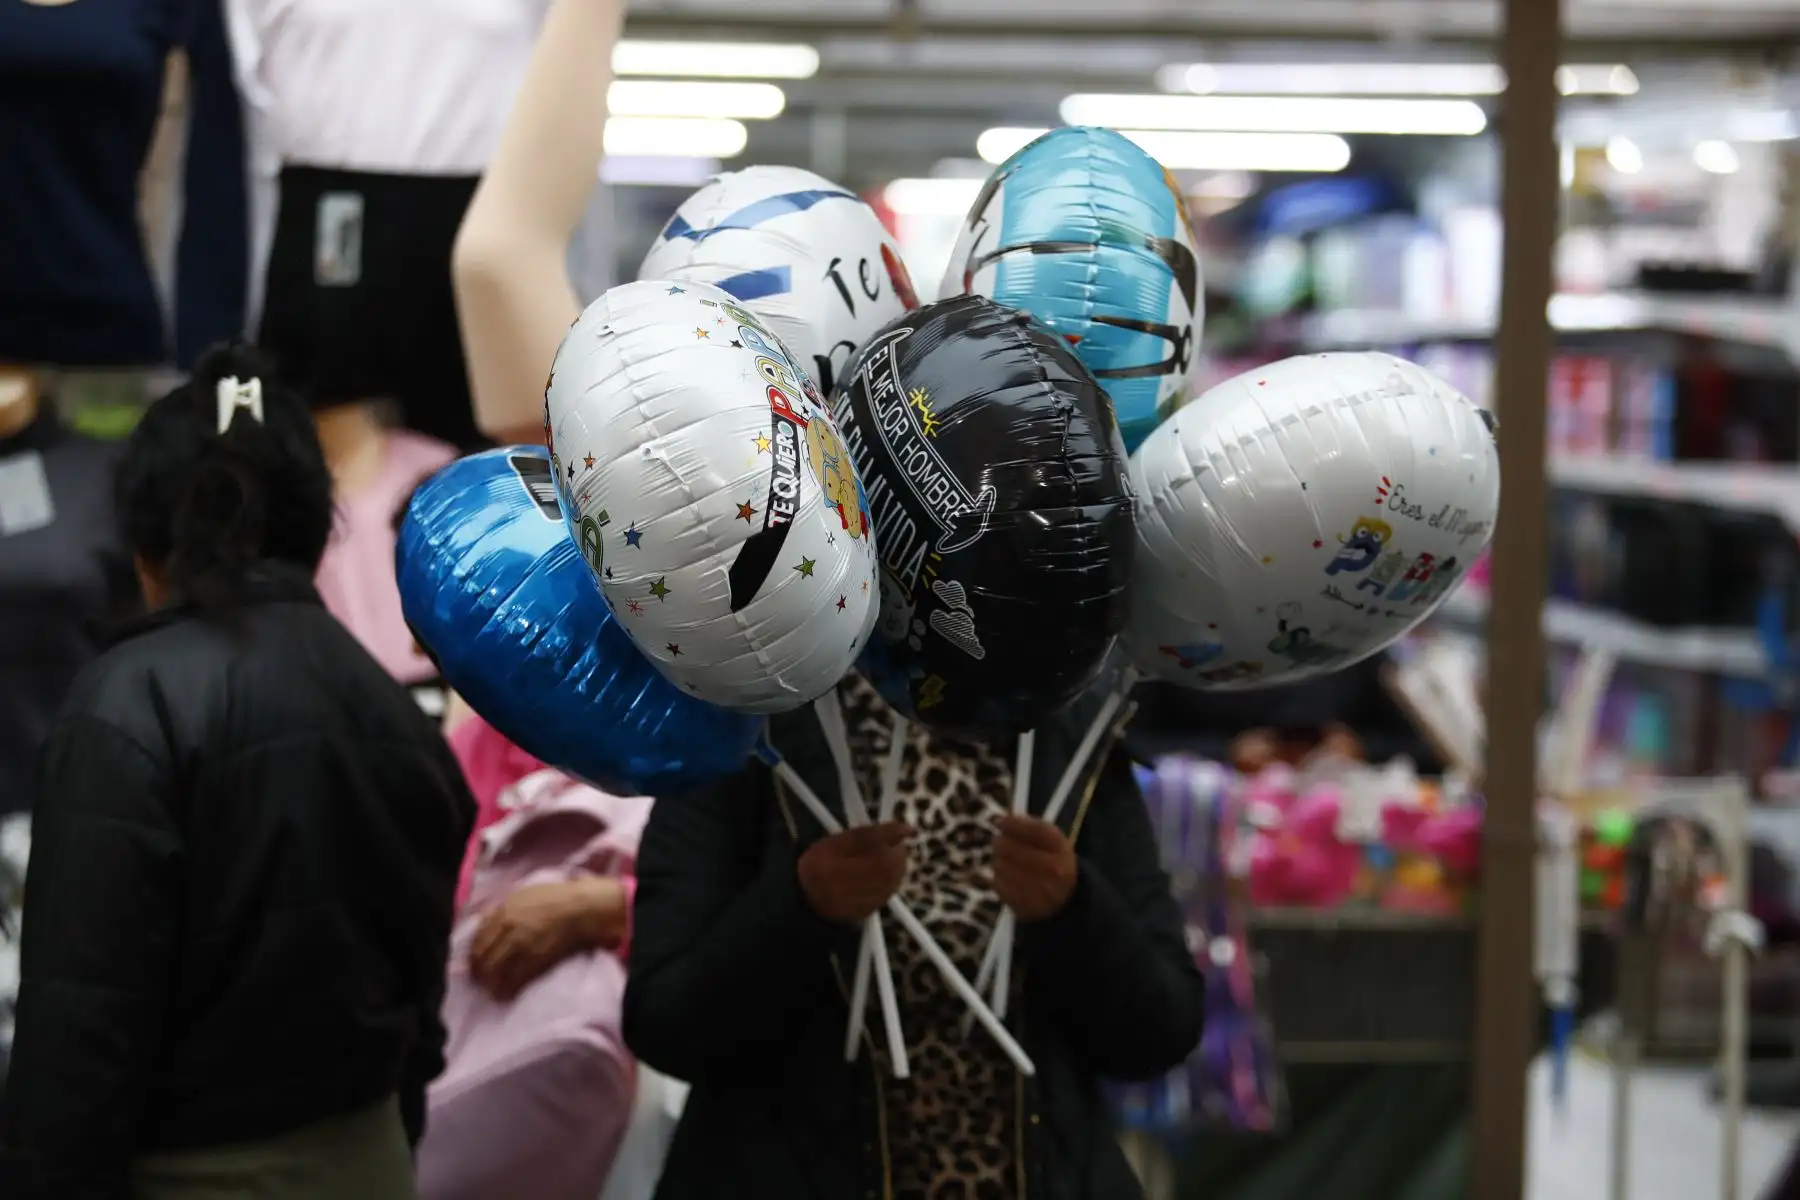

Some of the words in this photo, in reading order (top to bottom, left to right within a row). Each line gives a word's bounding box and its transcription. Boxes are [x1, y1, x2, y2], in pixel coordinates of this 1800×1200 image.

[822, 257, 880, 320] Te
[867, 345, 889, 380] EL
[871, 369, 909, 446] MEJOR
[767, 500, 795, 529] TE
[899, 436, 973, 530] HOMBRE
[1388, 483, 1425, 521] Eres
[874, 488, 928, 593] VIDA
